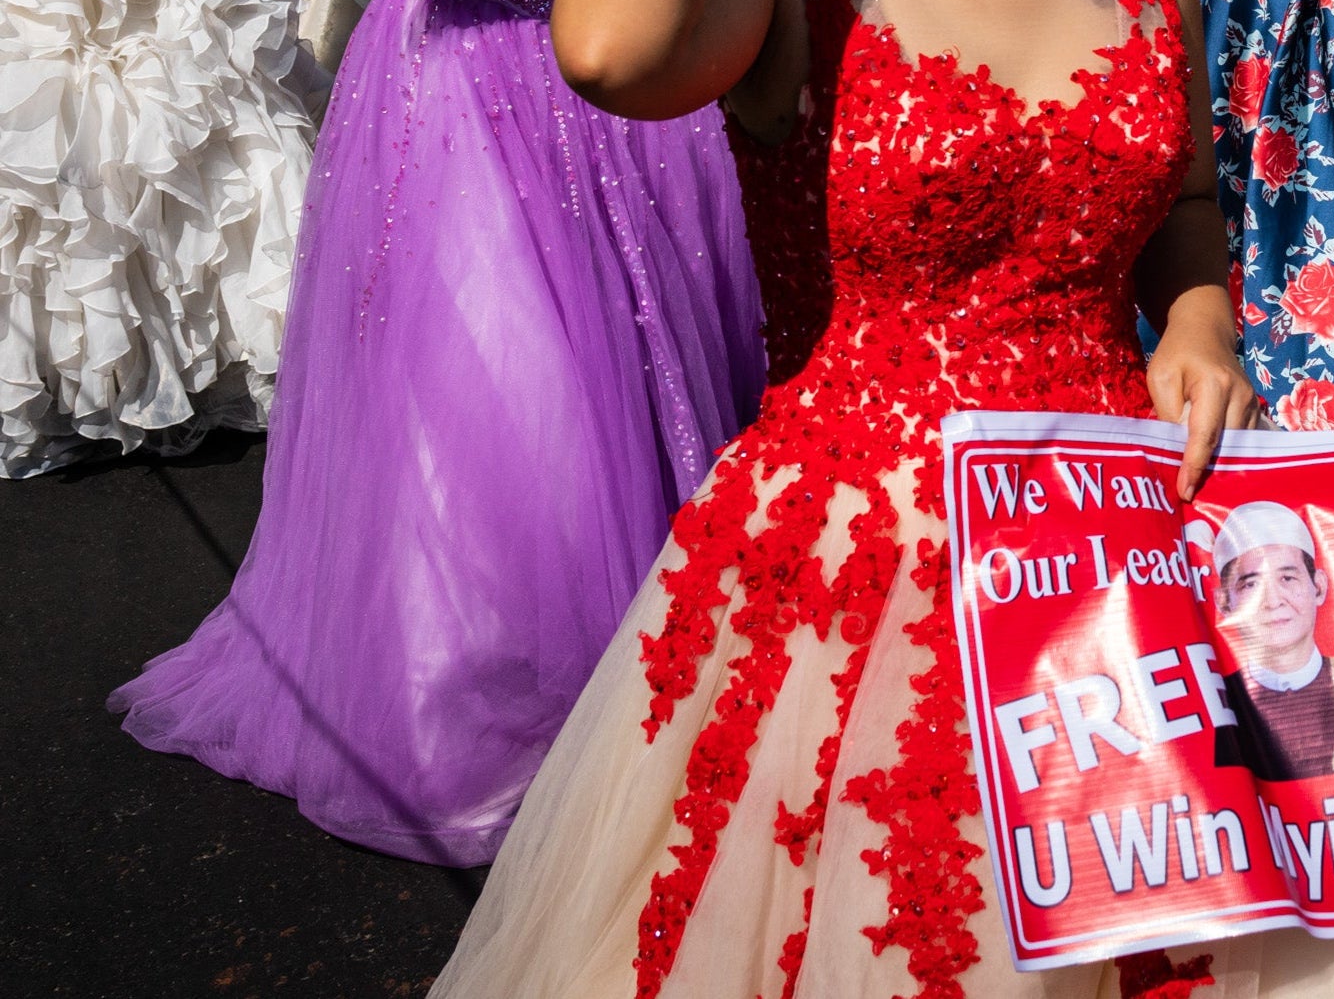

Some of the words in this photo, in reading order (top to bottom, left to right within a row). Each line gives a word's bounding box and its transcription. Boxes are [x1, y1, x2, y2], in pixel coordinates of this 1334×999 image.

[971, 462, 1048, 521] We
[1054, 460, 1176, 515] Want
[979, 546, 1077, 604] Our
[1086, 534, 1211, 602] Leadr
[994, 641, 1239, 795] FREE
[1014, 819, 1073, 909] U
[1091, 794, 1252, 894] Win
